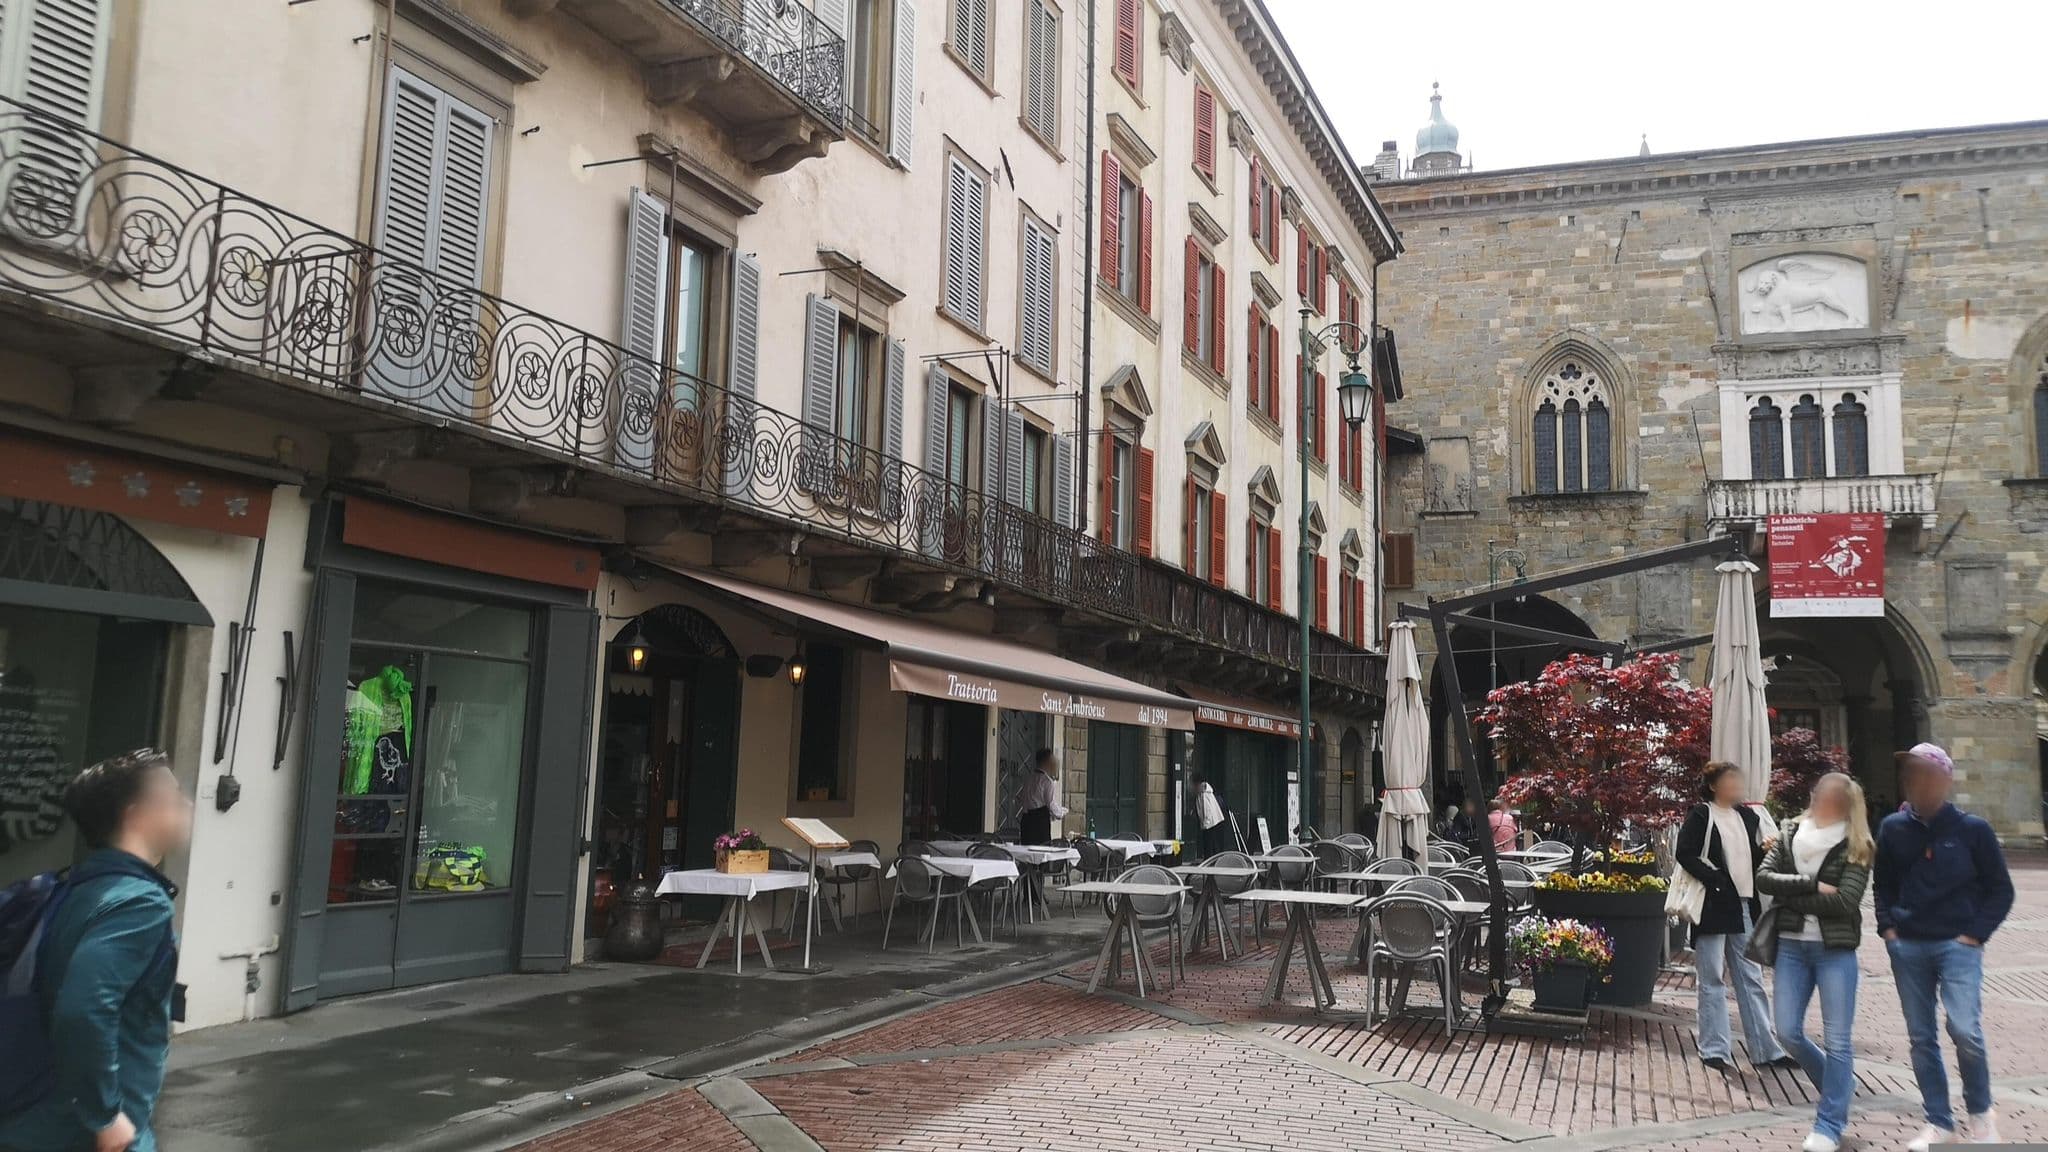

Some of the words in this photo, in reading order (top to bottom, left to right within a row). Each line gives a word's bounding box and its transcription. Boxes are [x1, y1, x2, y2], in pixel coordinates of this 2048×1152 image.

[1782, 516, 1817, 524] fabbriche
[1771, 524, 1804, 533] pensanti
[947, 674, 998, 703] Trattoria
[1138, 704, 1150, 723] dal
[1151, 707, 1168, 726] 1994
